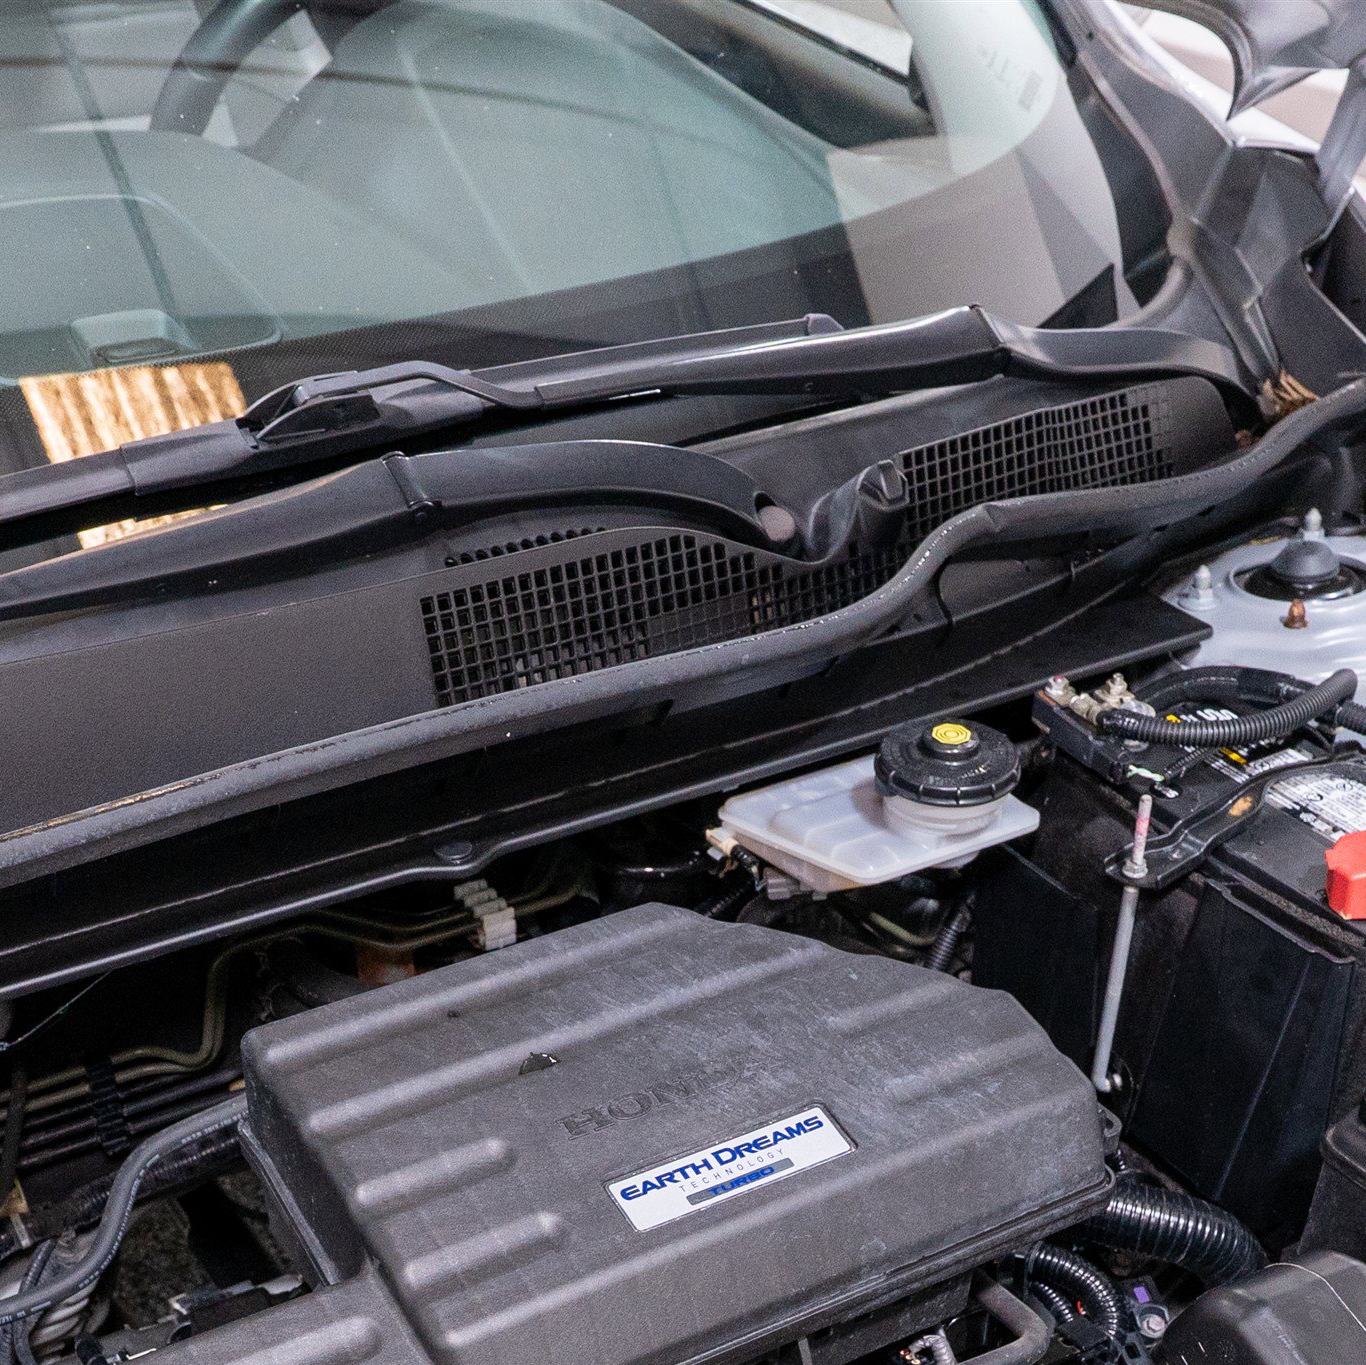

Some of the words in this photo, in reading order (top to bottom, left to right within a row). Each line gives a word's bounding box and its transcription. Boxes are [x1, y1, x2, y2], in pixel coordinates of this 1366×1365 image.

[620, 1158, 714, 1201] EARTH
[711, 1115, 823, 1167] DREAMS
[679, 1148, 785, 1193] TECHNOLOGY
[707, 1165, 775, 1196] TURBO
